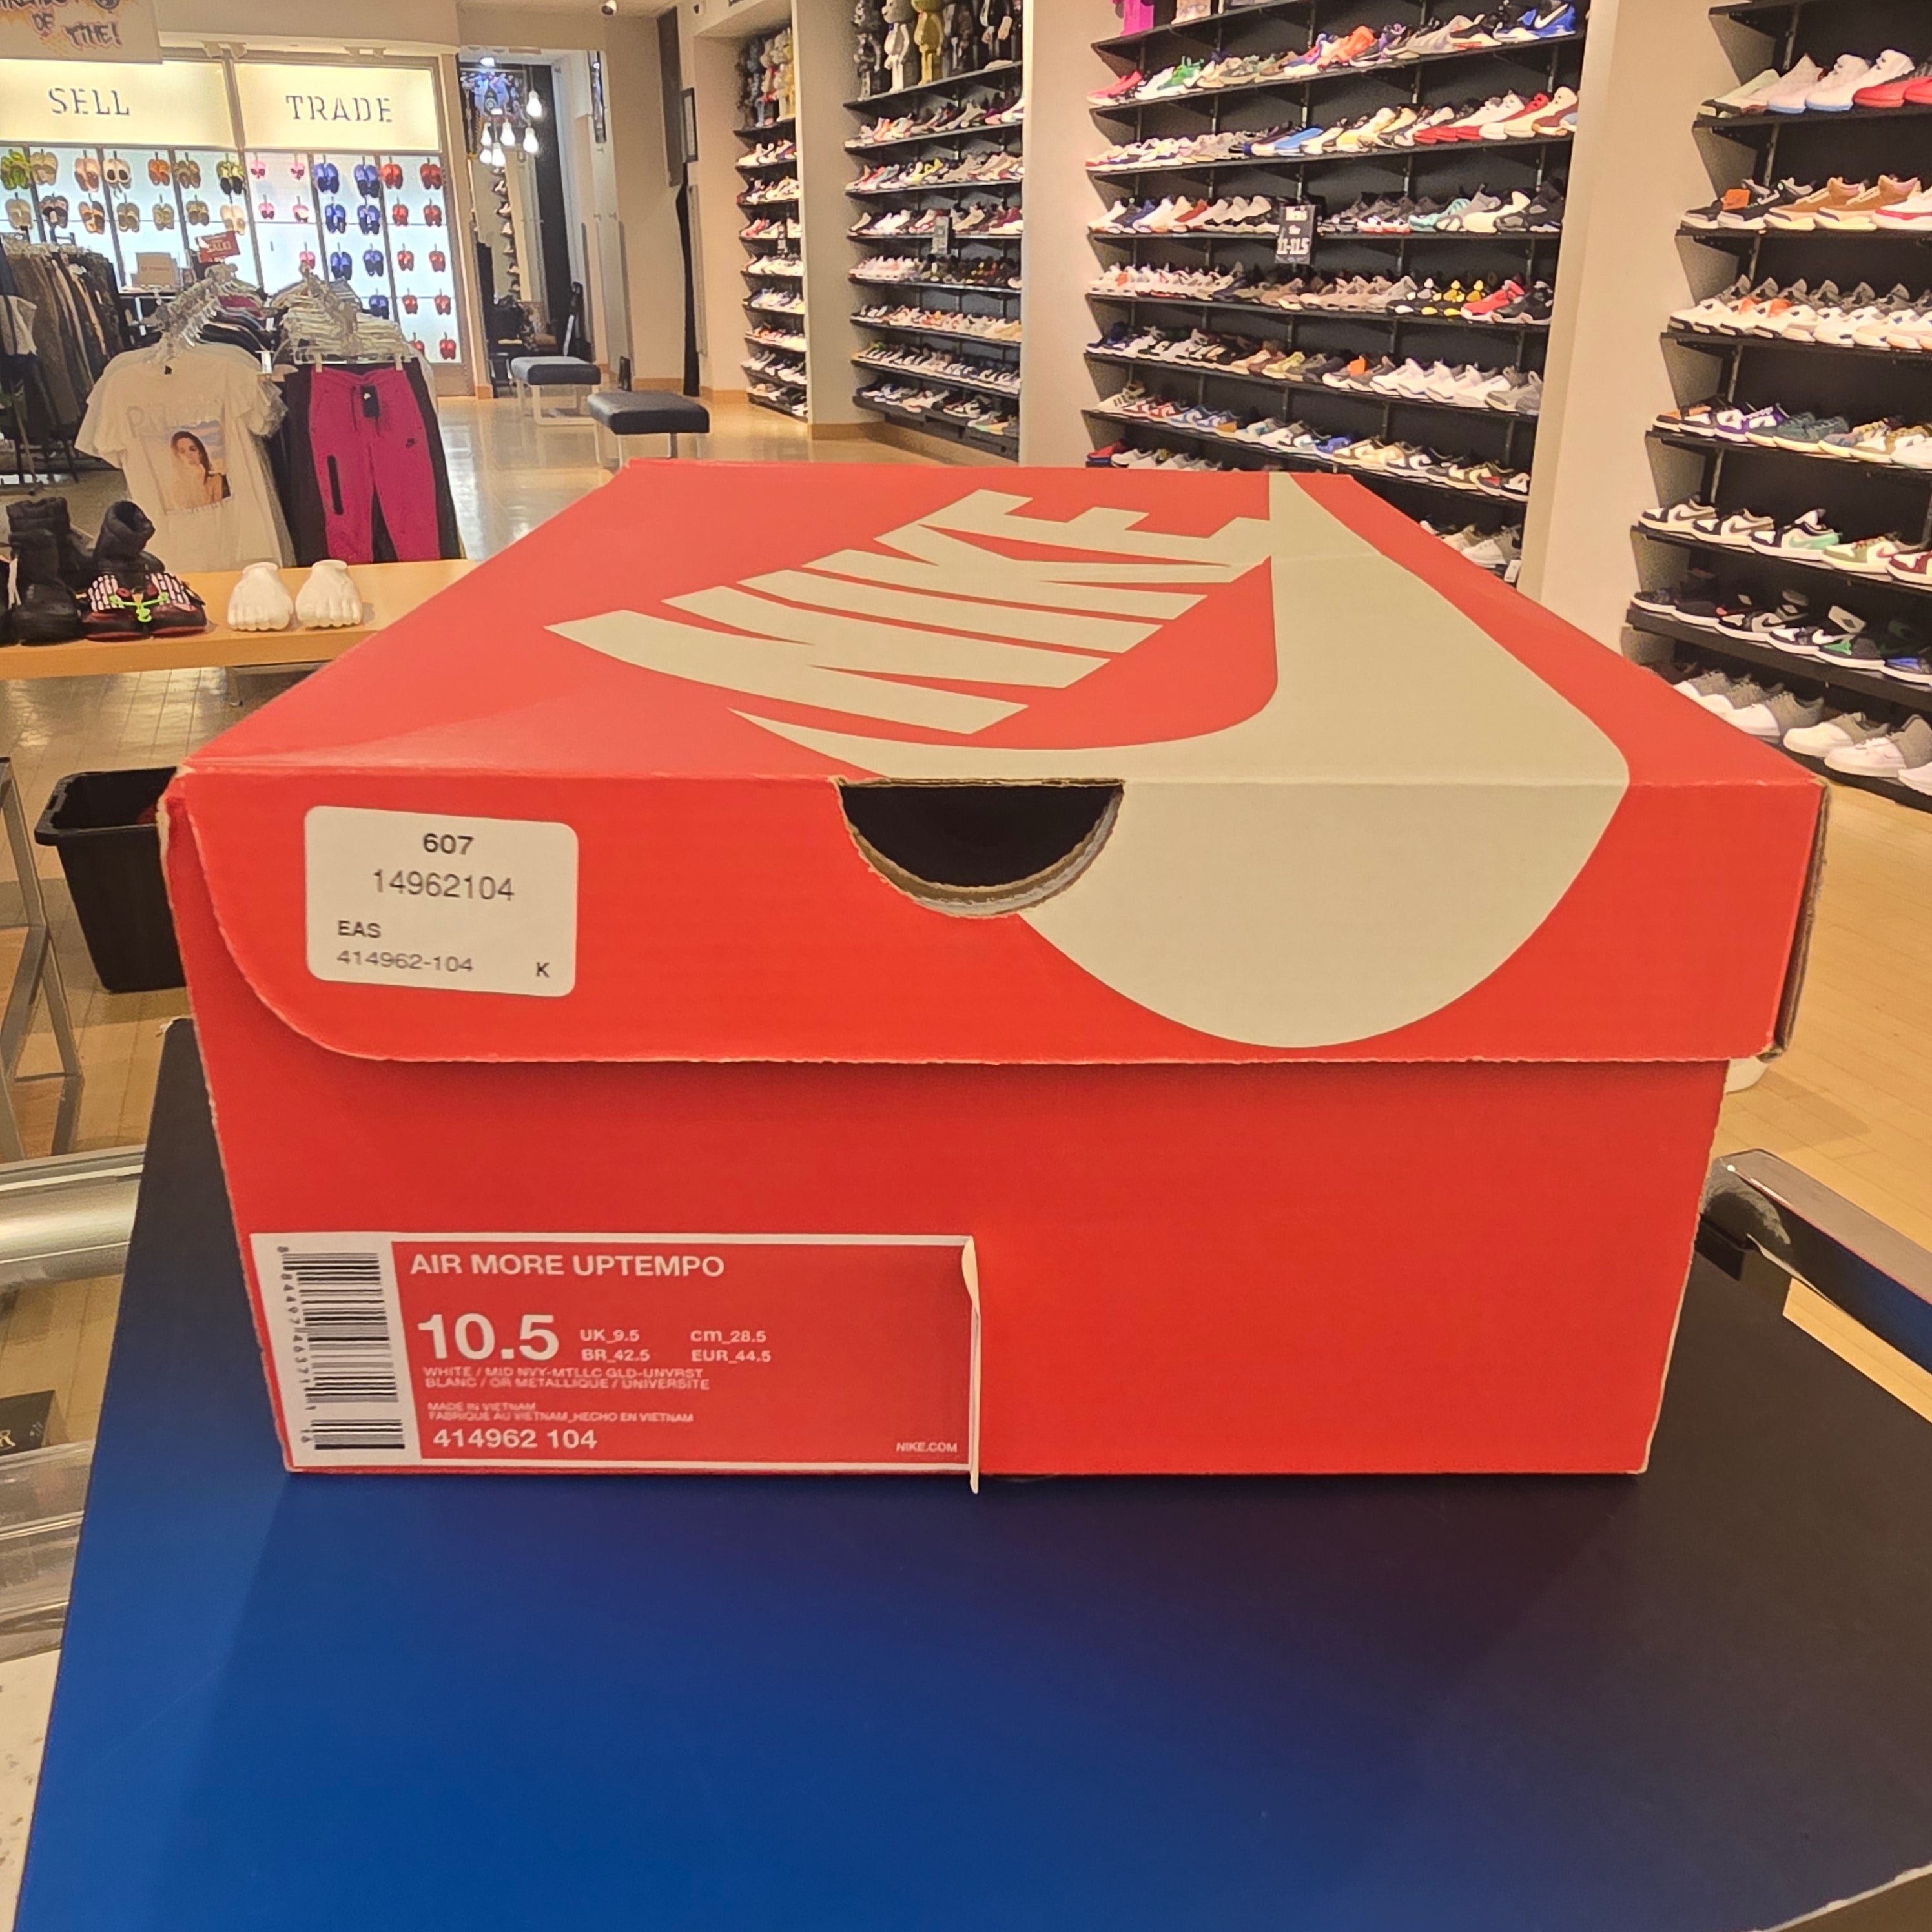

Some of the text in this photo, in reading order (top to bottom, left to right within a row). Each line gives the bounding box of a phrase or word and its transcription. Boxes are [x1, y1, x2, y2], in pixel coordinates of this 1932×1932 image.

[49, 88, 130, 115] SELL
[285, 95, 393, 123] TRADE
[542, 489, 1271, 735] NIKE
[423, 833, 474, 855] 607
[373, 869, 515, 901] 14962104
[338, 921, 382, 938] EAS
[336, 950, 473, 972] 414962-104
[535, 962, 550, 978] K
[410, 1254, 724, 1277] AIR MORE UPTEMPO
[418, 1313, 559, 1361] 10.5
[580, 1329, 640, 1344] UK_9.5
[690, 1330, 766, 1344] cm_28.5
[581, 1348, 650, 1363] BR_42.5
[692, 1349, 772, 1364] EUR_44.5
[423, 1366, 472, 1376] WHITE
[486, 1367, 514, 1376] MID
[425, 1377, 477, 1388] BLANC
[489, 1378, 512, 1388] OR
[515, 1378, 608, 1388] METALLIQUE
[622, 1379, 710, 1390] UNIVERSITE
[427, 1402, 463, 1410] MADE
[482, 1402, 536, 1410] VIETNAM
[429, 1412, 490, 1420] FABRIQUE
[493, 1412, 510, 1420] AU
[620, 1412, 637, 1421] EN
[639, 1412, 694, 1422] VIETNAM
[433, 1428, 597, 1450] 414962 104
[896, 1441, 958, 1452] NIKE.COM
